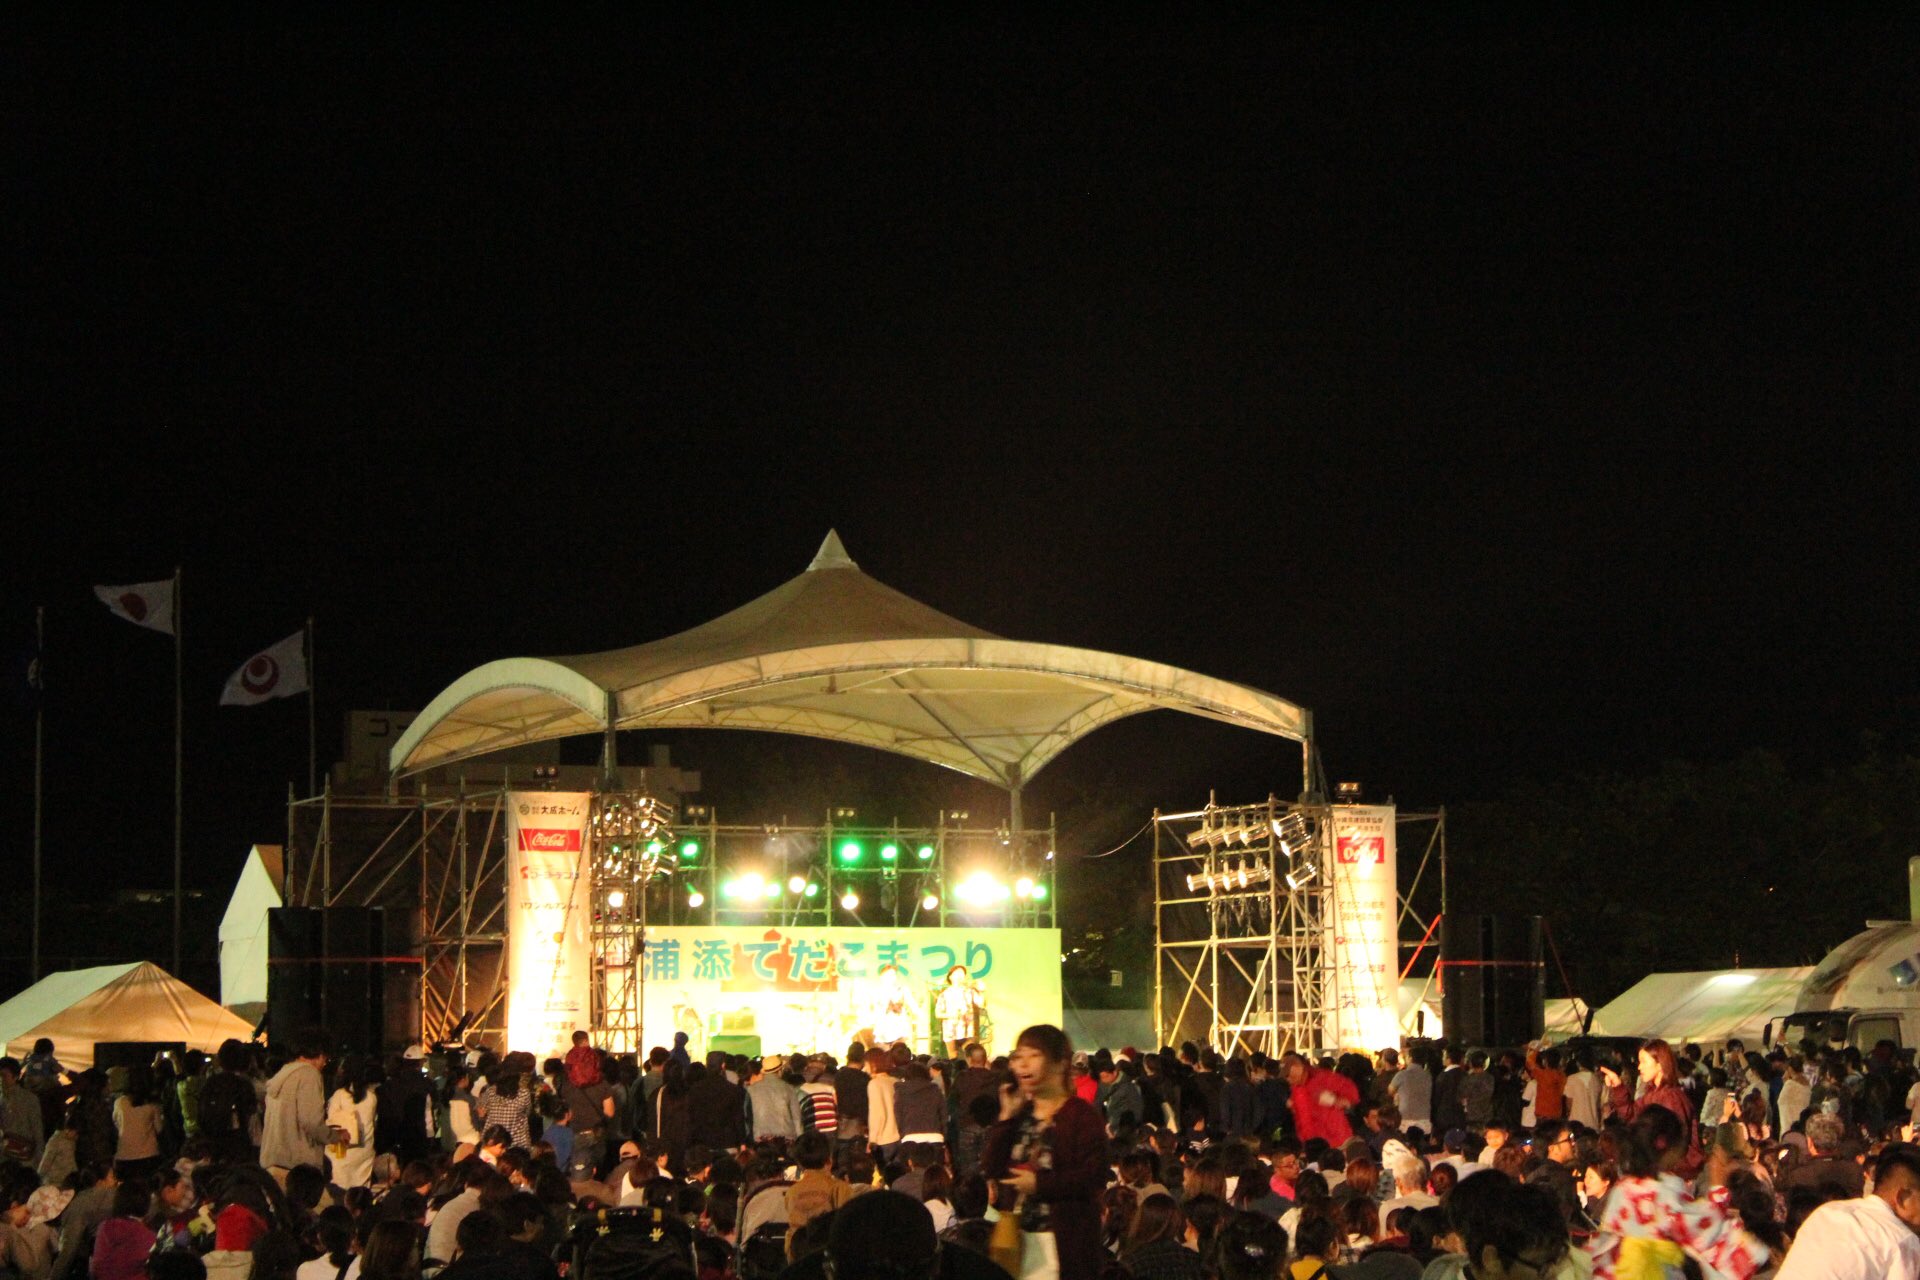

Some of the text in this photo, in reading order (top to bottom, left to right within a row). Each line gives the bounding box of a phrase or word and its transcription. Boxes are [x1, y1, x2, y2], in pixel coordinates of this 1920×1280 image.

[644, 937, 994, 982] 浦添てだこまつり
